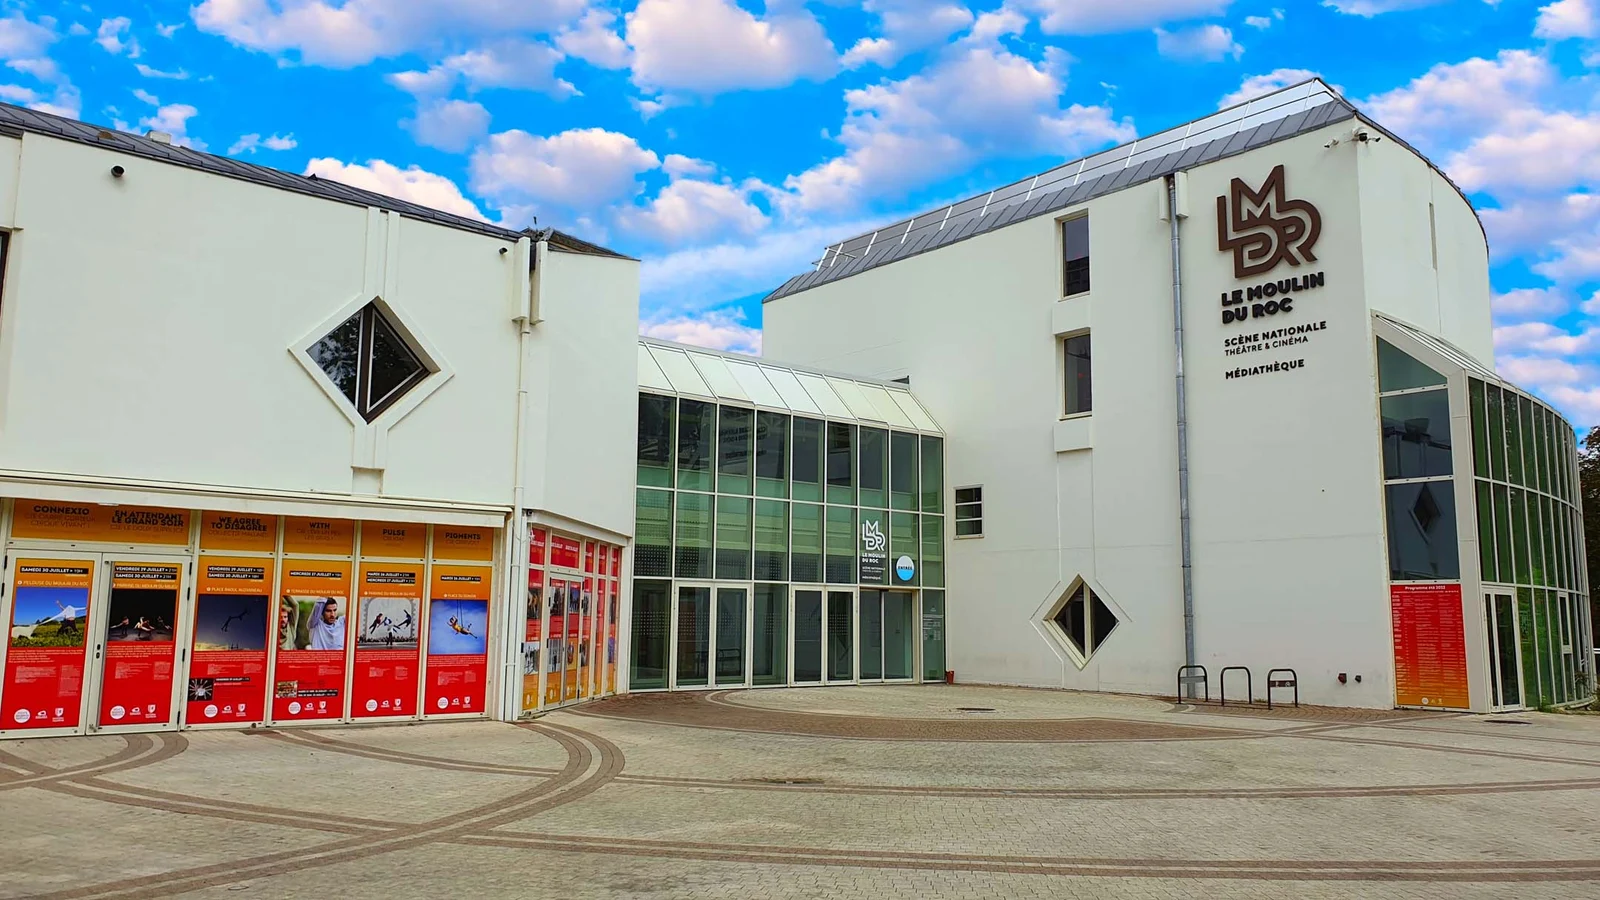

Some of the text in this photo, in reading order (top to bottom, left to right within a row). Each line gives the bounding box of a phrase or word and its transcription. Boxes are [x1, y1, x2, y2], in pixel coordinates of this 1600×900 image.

[1221, 271, 1325, 306] LE MOULIN
[1222, 297, 1294, 324] DU ROC
[1224, 320, 1327, 348] SCÈNE NATIONALE
[1224, 335, 1309, 356] THÉÂTRE & CINÉMA
[1225, 358, 1305, 380] MÉDIATHÈQUE
[33, 504, 90, 515] CONNEXIO
[129, 512, 183, 520] ATTENDANT
[125, 517, 158, 526] GRAND
[160, 519, 184, 527] SOIR
[224, 524, 268, 532] DISAGREE
[382, 528, 406, 536] PULSE
[446, 532, 481, 540] PIGMENTS
